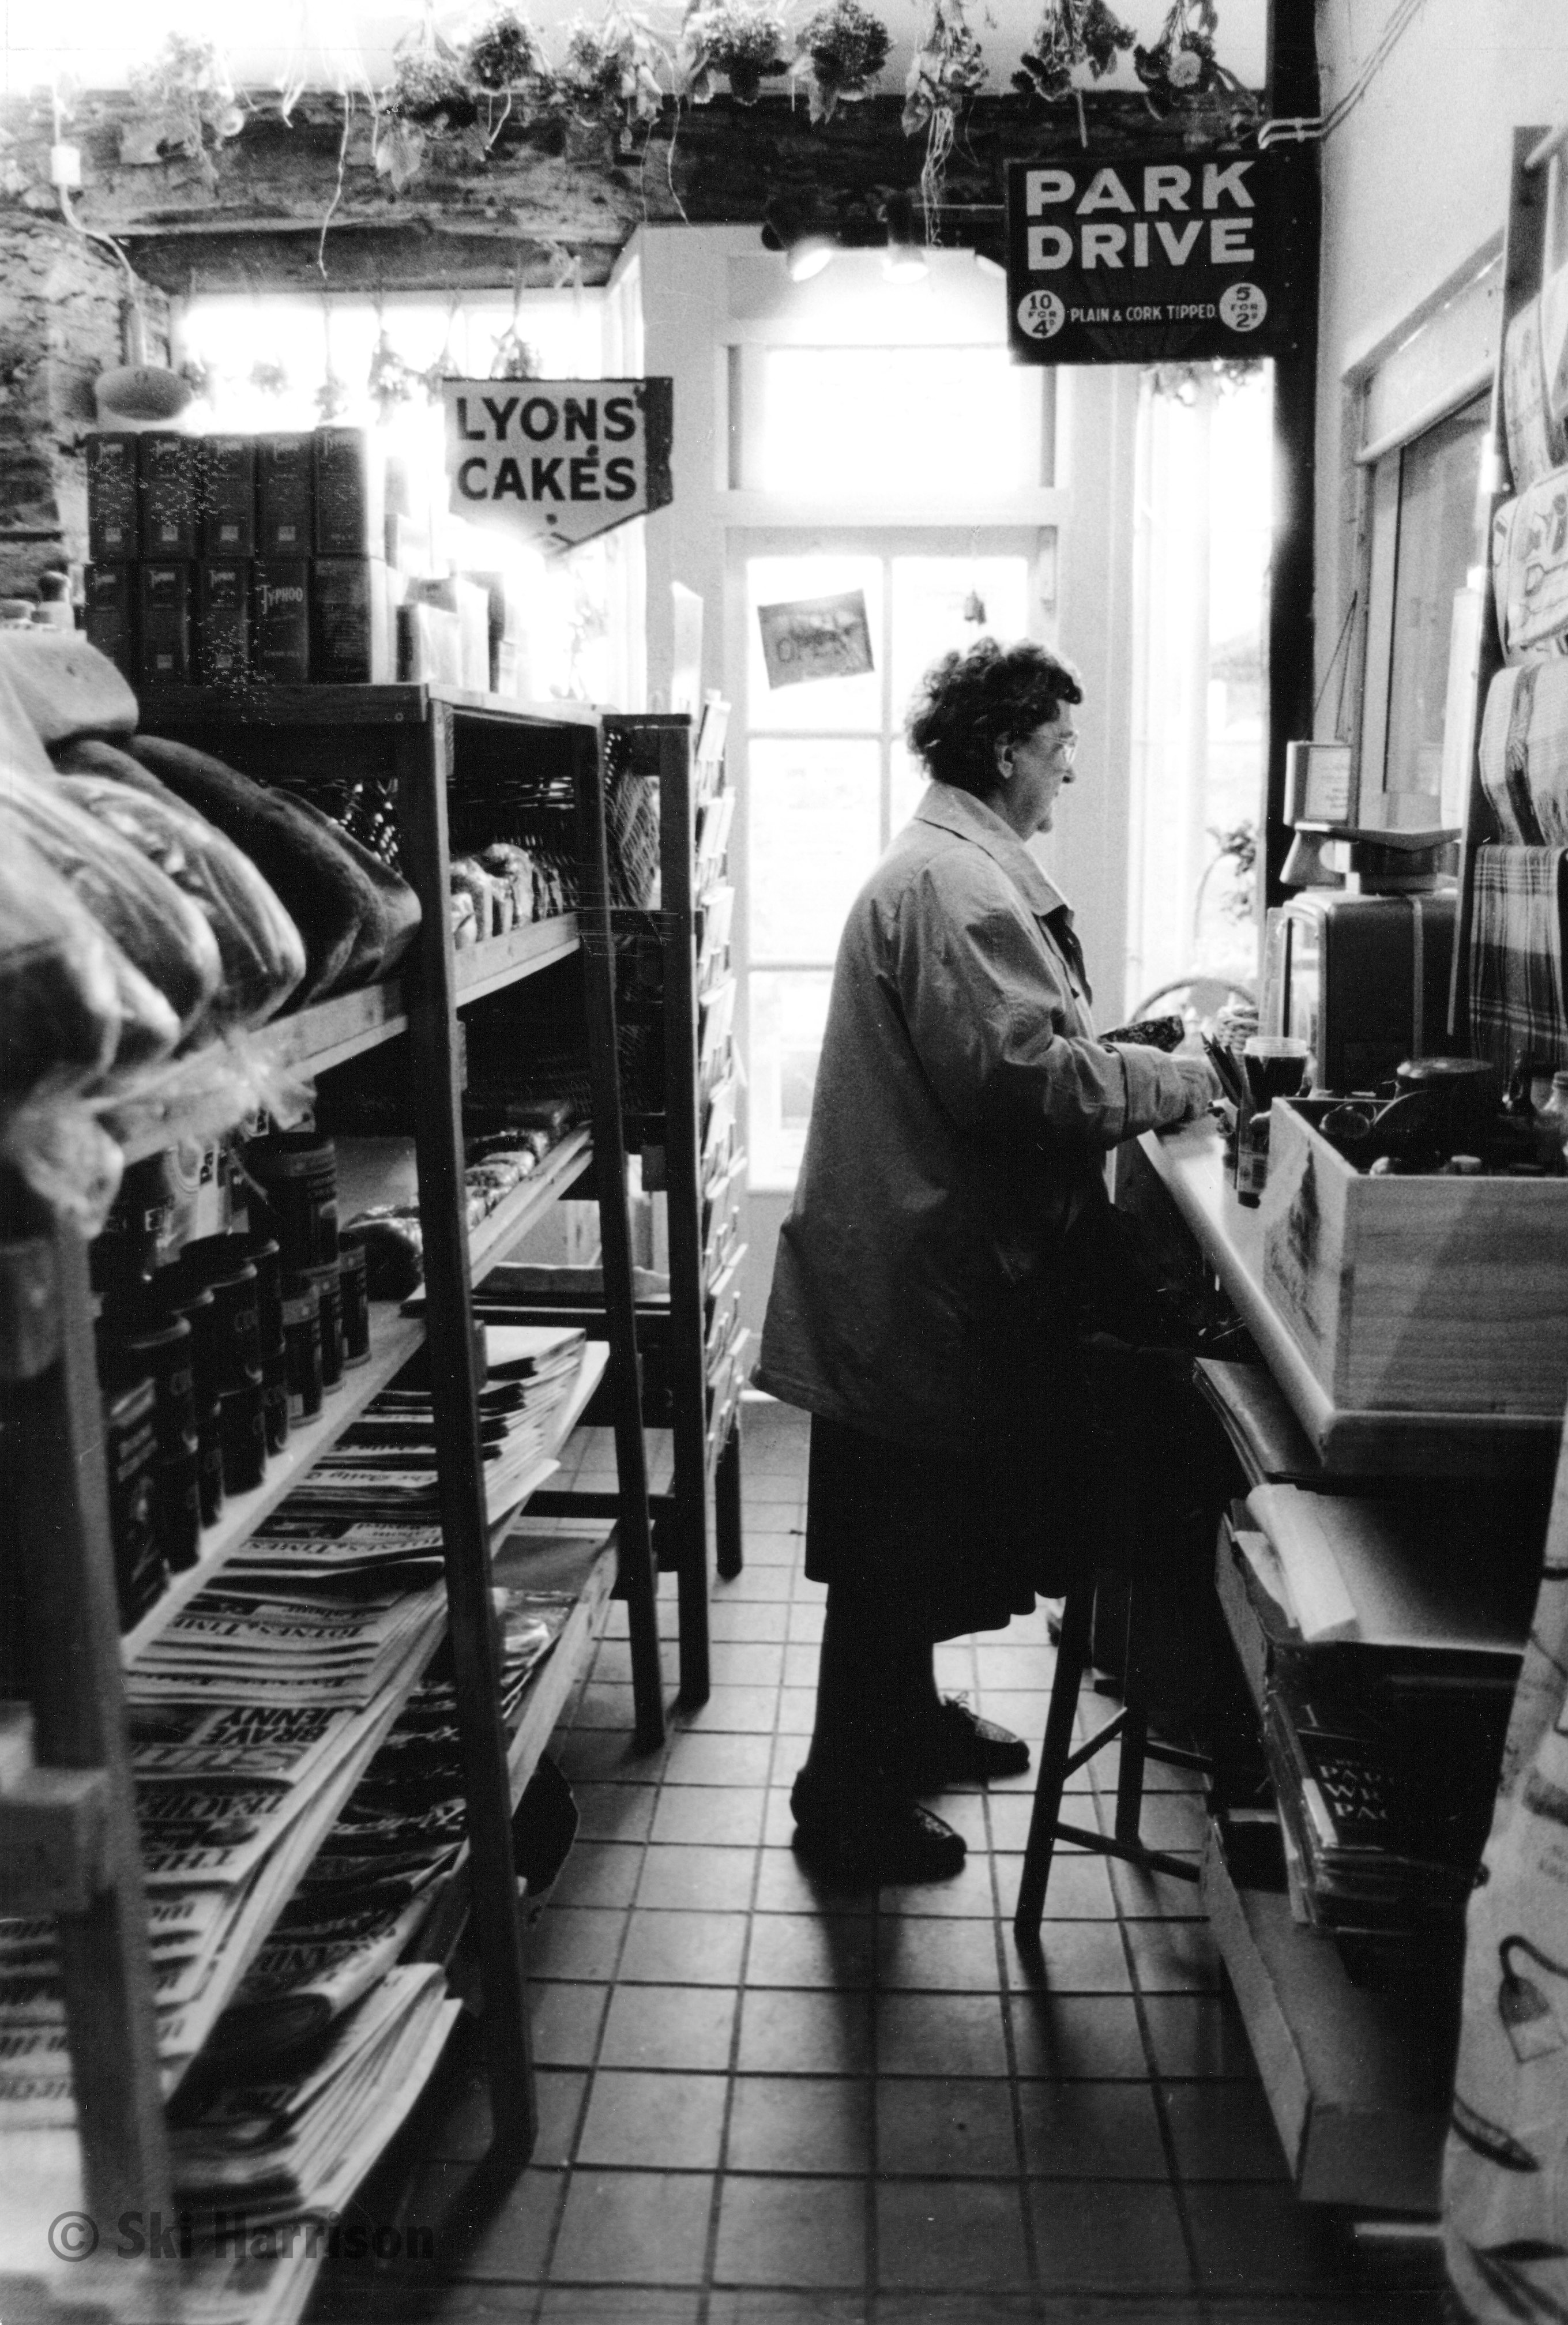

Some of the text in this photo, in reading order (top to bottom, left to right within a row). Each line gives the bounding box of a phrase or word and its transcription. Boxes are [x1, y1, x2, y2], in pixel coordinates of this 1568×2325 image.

[1026, 161, 1255, 216] PARK
[1027, 217, 1255, 270] DRIVE
[1026, 293, 1052, 310] 10
[1236, 285, 1251, 300] 5
[1070, 303, 1216, 322] PLAIN & CORK TIPPED
[457, 396, 636, 442] LYONS
[458, 457, 637, 501] CAKES
[217, 1707, 344, 1726] JENNY
[198, 1726, 329, 1745] BRAVE
